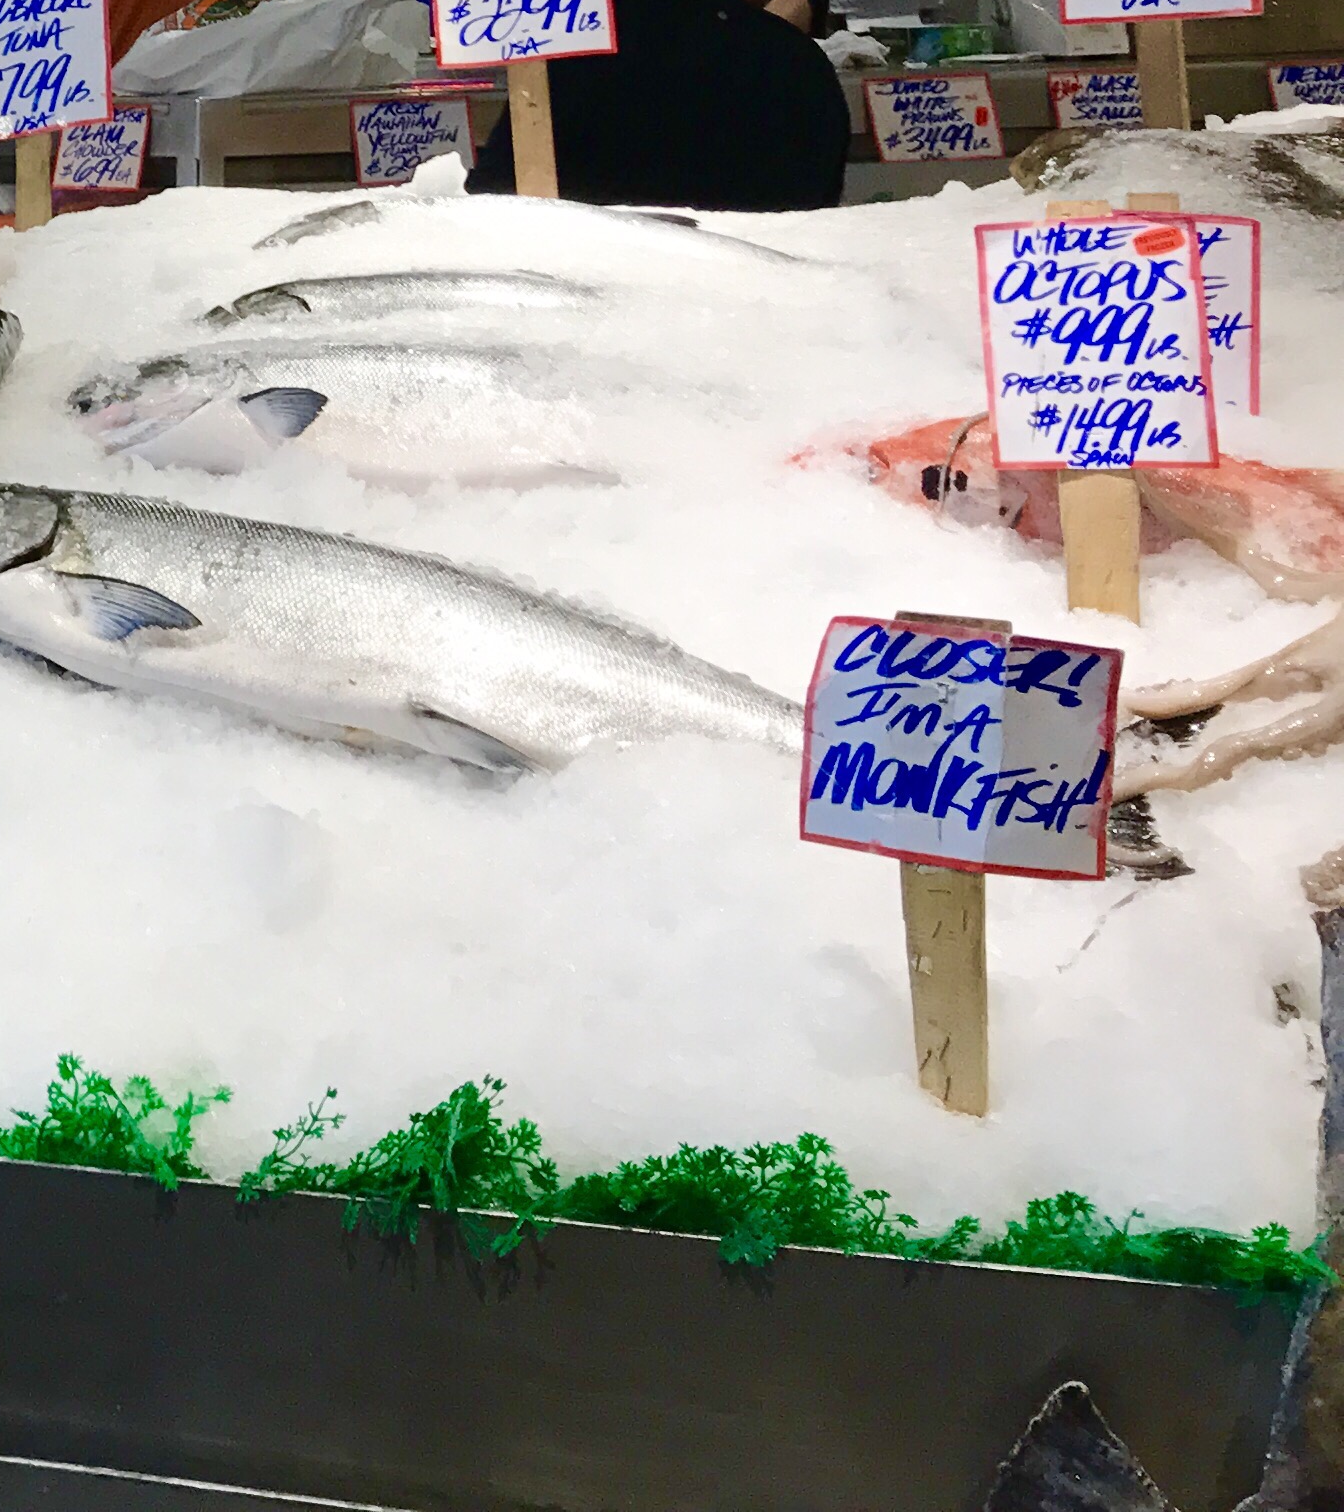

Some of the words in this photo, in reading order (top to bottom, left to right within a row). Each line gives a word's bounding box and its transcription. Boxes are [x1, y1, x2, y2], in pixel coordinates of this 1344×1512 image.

[501, 37, 553, 61] USA
[875, 80, 950, 95] JUMBO
[1086, 75, 1140, 92] ALASK
[13, 111, 56, 134] USA
[357, 110, 443, 133] HAWAIIAN
[1070, 106, 1142, 121] SCALLO
[67, 124, 126, 144] CLAM
[367, 125, 459, 157] YELLOWFIN
[62, 140, 140, 159] CHOWDER
[1013, 222, 1148, 259] WHOLE
[993, 259, 1188, 306] OCTOPUS
[1002, 373, 1084, 398] PIECES
[1088, 373, 1124, 393] OF
[1127, 371, 1209, 397] OCTOPUS
[1068, 449, 1135, 468] SPAIN
[833, 624, 1102, 707] CLOSER!
[835, 683, 943, 737] I'M
[944, 703, 1002, 753] A
